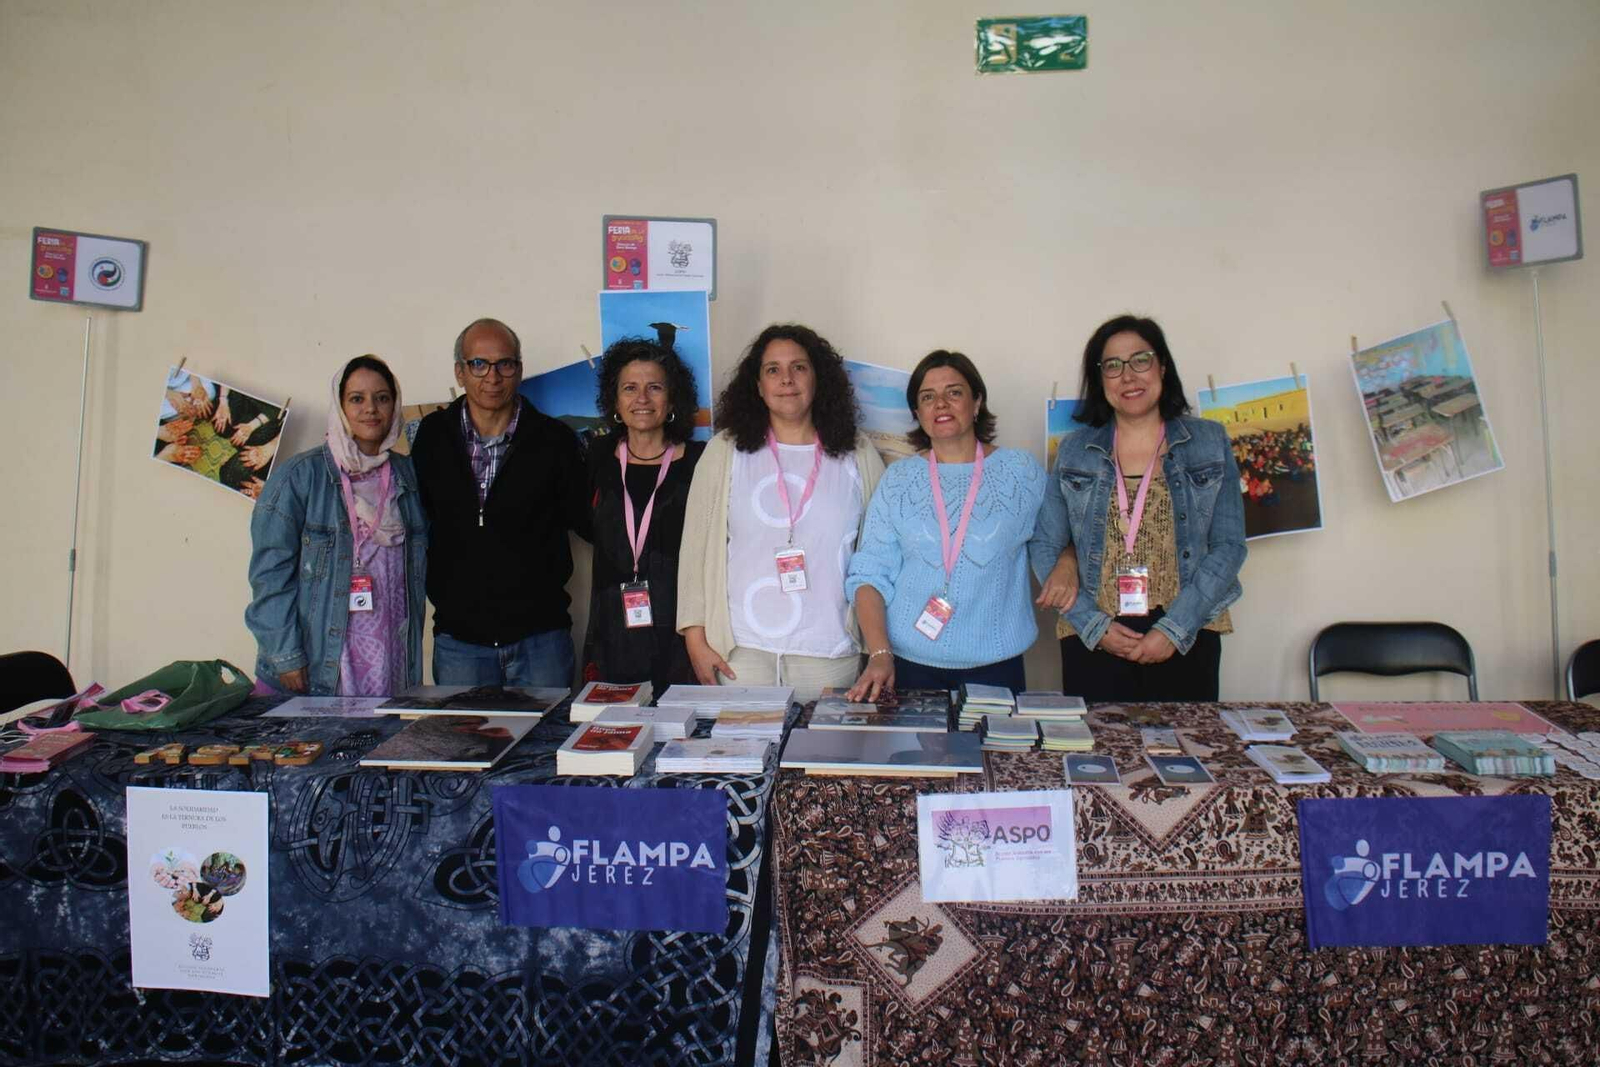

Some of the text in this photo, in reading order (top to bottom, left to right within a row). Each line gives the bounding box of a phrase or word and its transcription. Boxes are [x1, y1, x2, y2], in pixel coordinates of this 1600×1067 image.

[608, 226, 630, 235] FERIA
[992, 824, 1050, 844] ASPO
[572, 839, 716, 869] FLAMPA
[571, 865, 655, 885] JEREZ
[1382, 852, 1537, 879] FLAMPA
[1381, 878, 1471, 898] JEREZ
